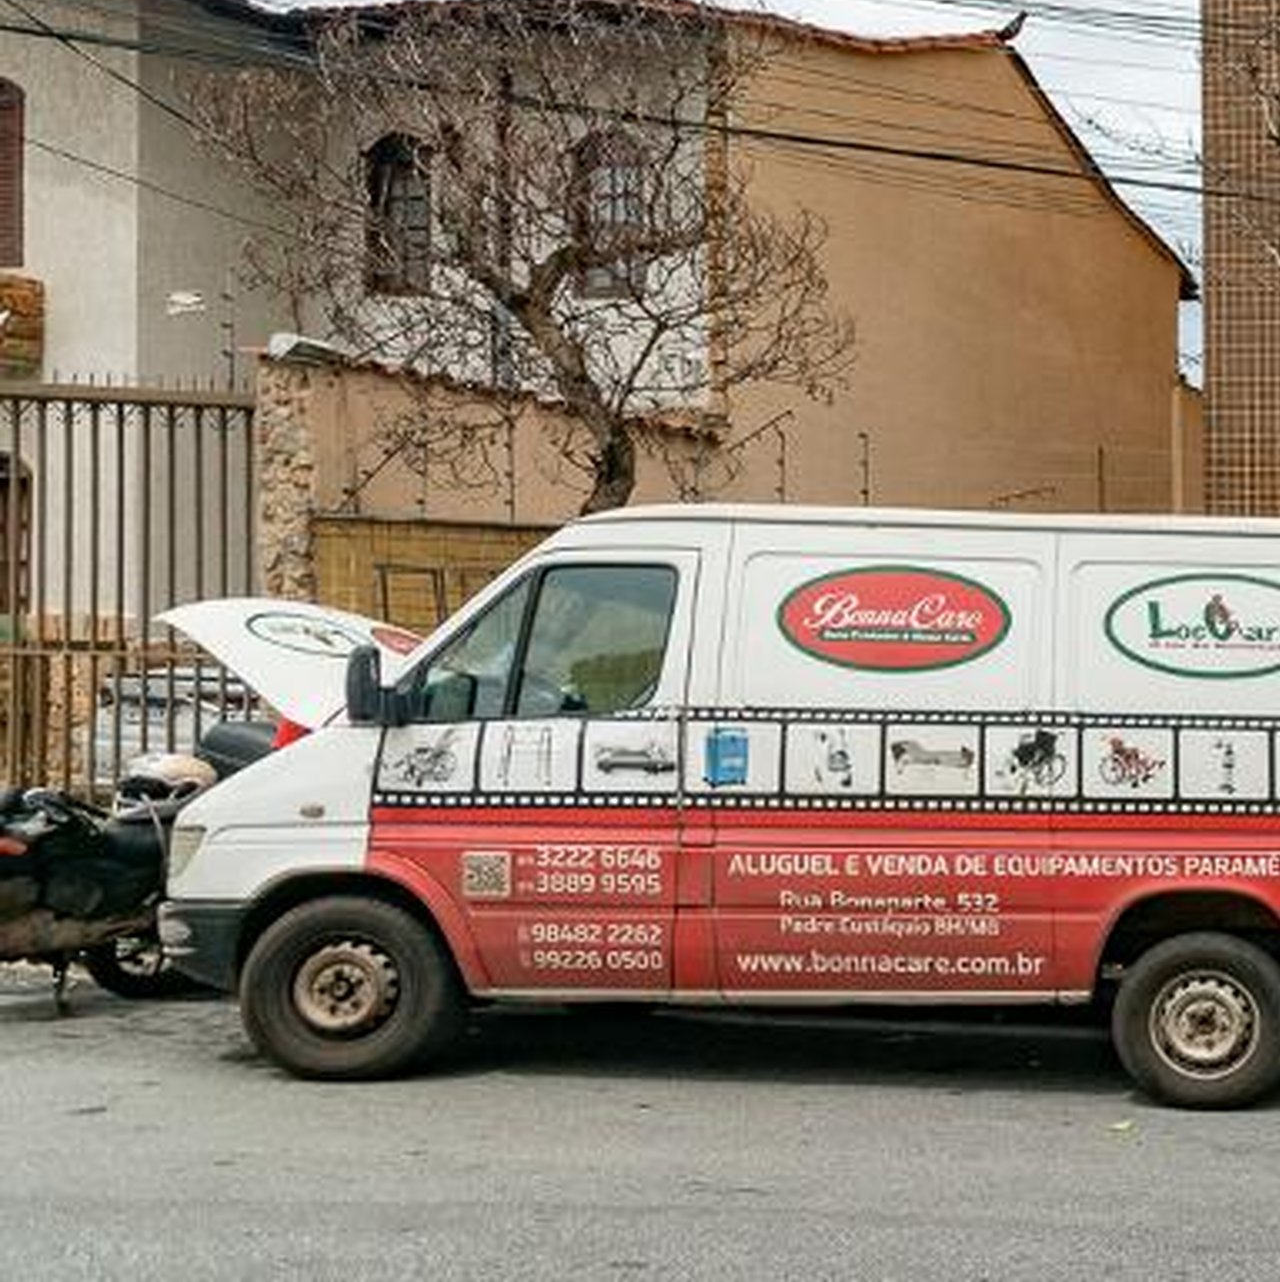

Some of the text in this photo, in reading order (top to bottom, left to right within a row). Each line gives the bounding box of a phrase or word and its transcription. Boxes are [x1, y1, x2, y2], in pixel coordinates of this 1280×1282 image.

[536, 845, 595, 868] 3222
[601, 845, 662, 870] 6646
[729, 853, 839, 876] ALUGUEL
[846, 854, 859, 876] E
[866, 854, 950, 876] VENDA
[955, 854, 987, 876] DE
[993, 854, 1178, 877] EQUIPAMENTOS
[536, 872, 595, 893] 3889
[600, 874, 662, 894] 9595
[779, 890, 822, 908] Rua
[956, 893, 1000, 913] 532
[531, 924, 601, 943] 98482
[608, 924, 662, 945] 2262
[780, 916, 835, 935] Padre
[533, 950, 602, 969] 99226
[607, 951, 662, 969] 0500
[736, 950, 1045, 975] www.bonnacare.com.br
